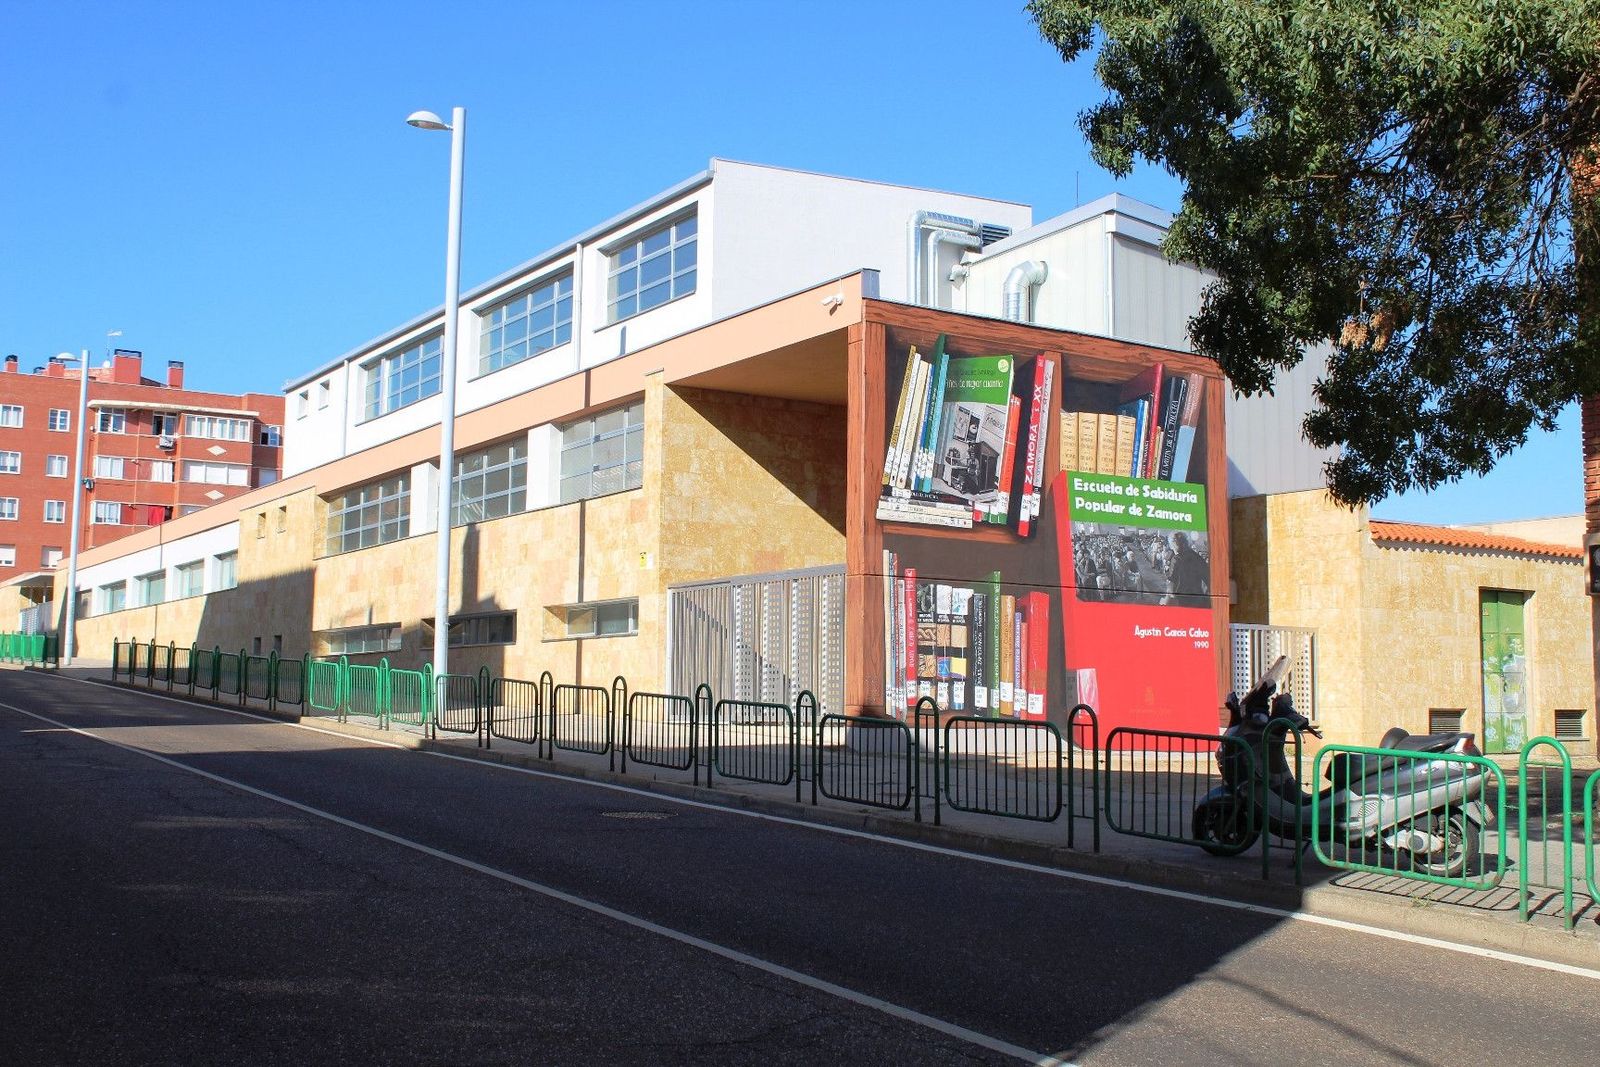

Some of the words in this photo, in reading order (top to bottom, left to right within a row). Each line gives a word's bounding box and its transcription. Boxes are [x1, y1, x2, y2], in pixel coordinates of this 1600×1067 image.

[1025, 424, 1038, 485] ZAMORA
[1033, 384, 1043, 402] XX
[1073, 477, 1123, 495] Escuela
[1125, 484, 1140, 497] de
[1142, 485, 1198, 504] Sabiduría
[1075, 497, 1126, 514] Popular
[1128, 503, 1143, 517] de
[1146, 504, 1193, 523] Zamora
[1188, 627, 1210, 638] Calvo
[1194, 640, 1210, 649] 1990
